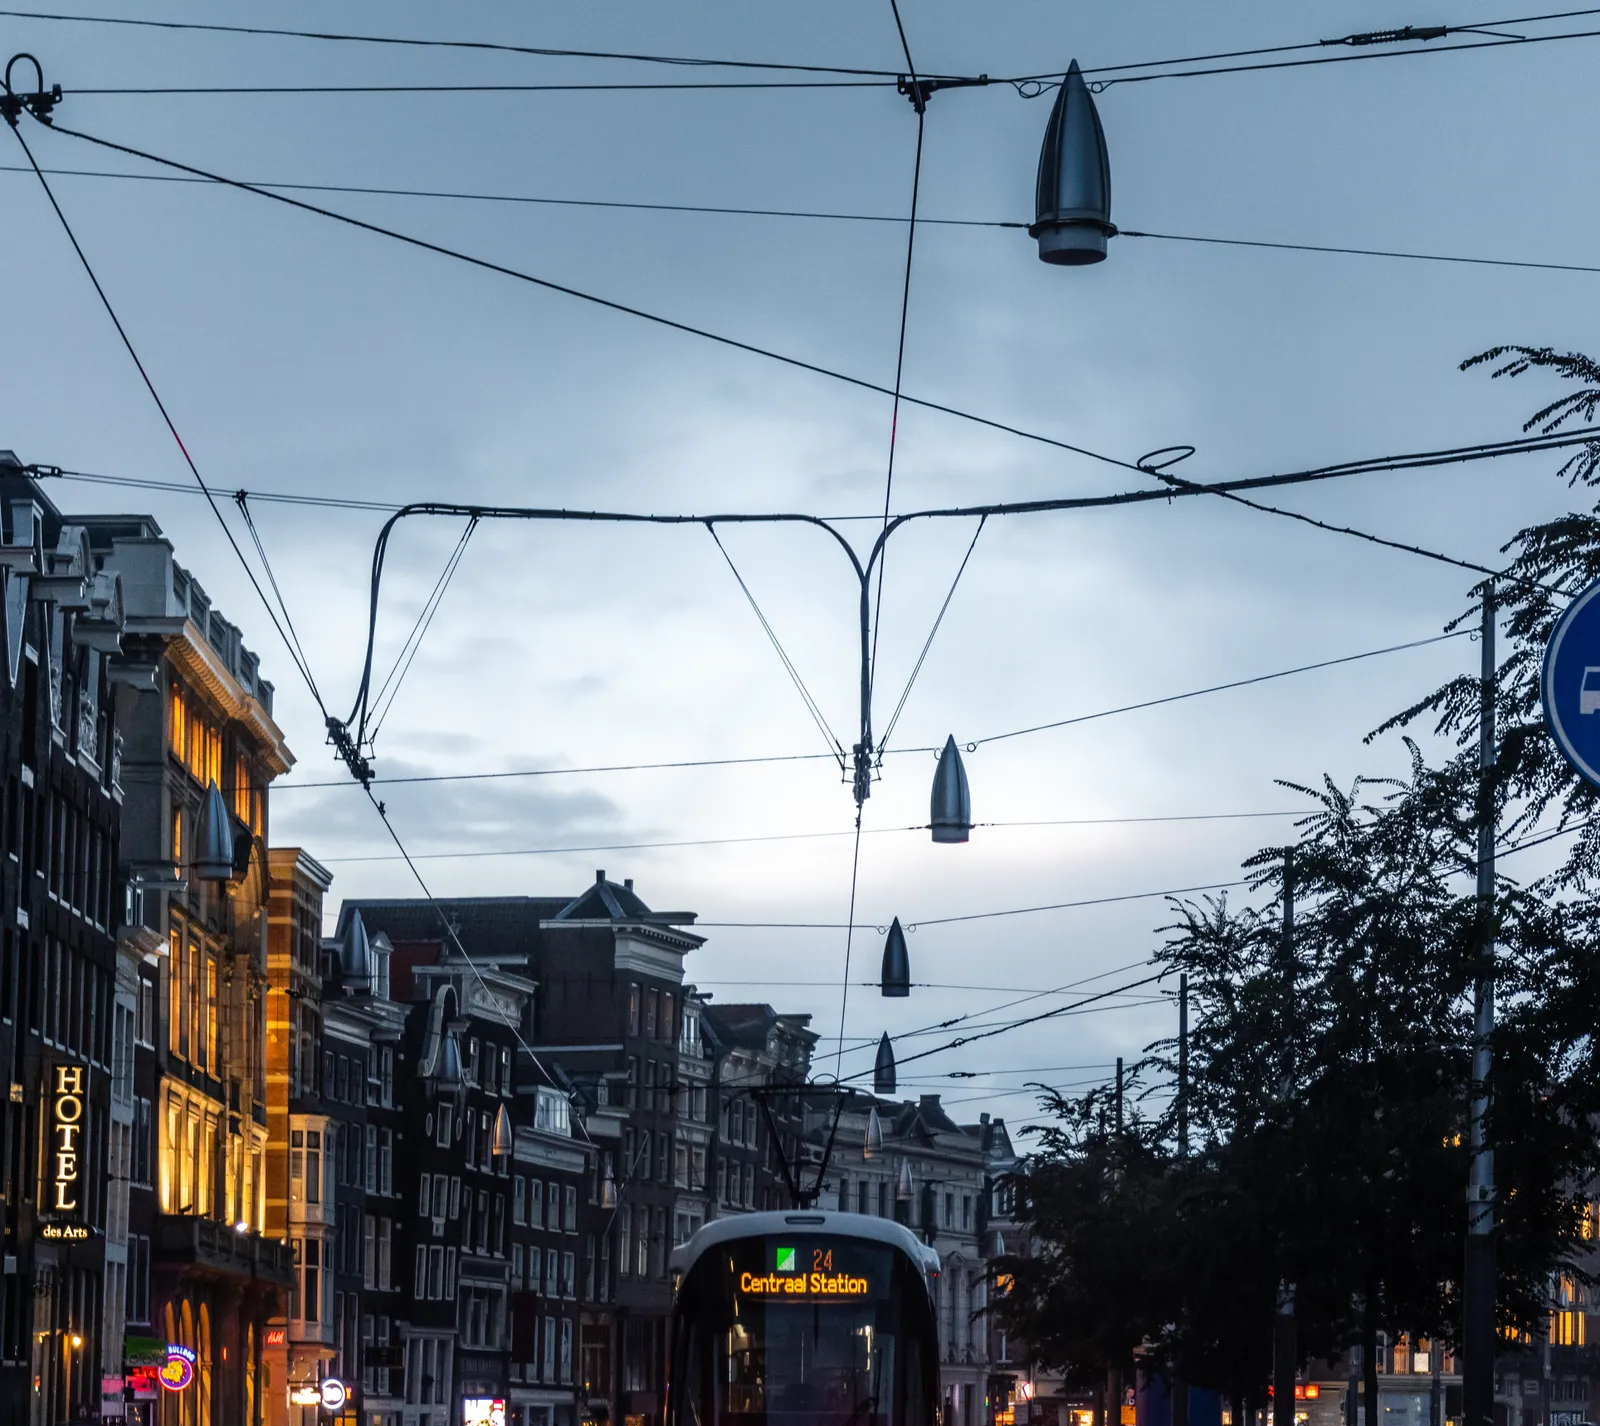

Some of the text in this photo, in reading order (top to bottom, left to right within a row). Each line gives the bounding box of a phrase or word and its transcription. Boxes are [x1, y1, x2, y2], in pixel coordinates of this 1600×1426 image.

[55, 1066, 83, 1209] HOTEL
[43, 1225, 88, 1238] des Arts
[813, 1248, 832, 1271] 24
[741, 1272, 867, 1293] Centraal Station
[168, 1346, 195, 1362] BULLDOG
